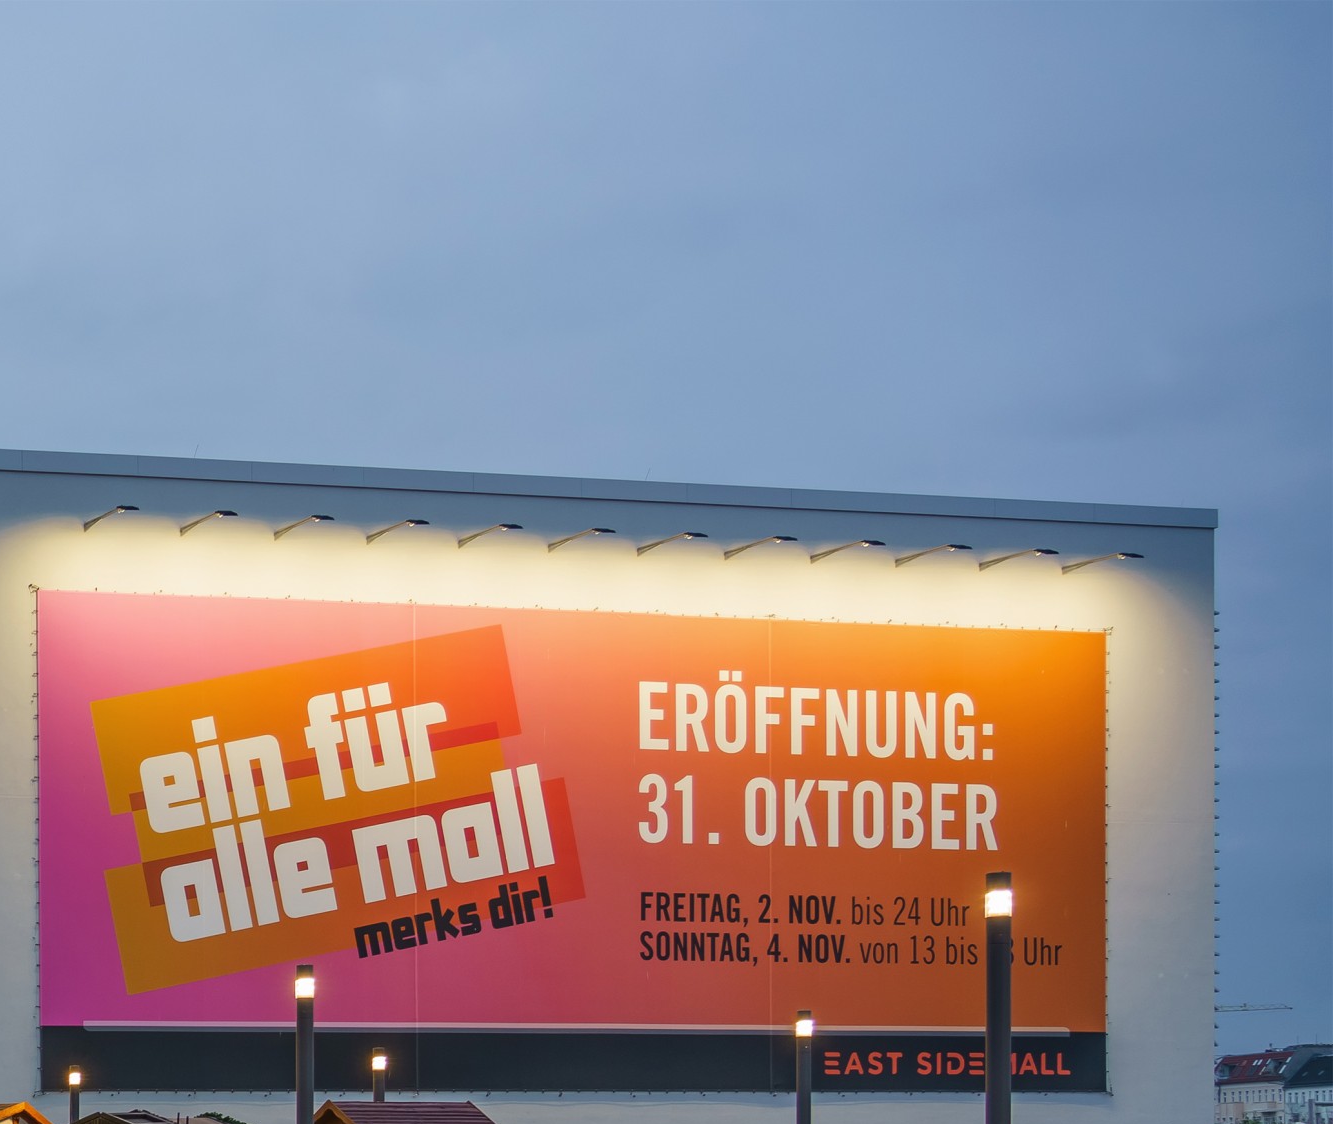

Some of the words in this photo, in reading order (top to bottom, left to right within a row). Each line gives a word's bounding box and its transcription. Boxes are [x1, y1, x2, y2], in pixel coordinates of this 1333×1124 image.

[638, 670, 994, 761] ERÖFFNUNG:
[139, 716, 291, 834] ein
[304, 682, 448, 801] für
[638, 773, 720, 846] 31.
[744, 776, 999, 851] OKTOBER
[160, 819, 338, 943] alle
[352, 763, 556, 905] mall
[353, 897, 481, 959] merks
[487, 875, 554, 930] dir!
[639, 891, 749, 929] FREITAG,
[757, 894, 780, 924] 2.
[788, 895, 842, 926] NOV.
[850, 896, 885, 926] bis
[893, 897, 922, 927] 24
[930, 897, 971, 928] Uhr
[639, 931, 759, 967] SONNTAG,
[766, 933, 789, 963] 4.
[797, 934, 851, 964] NOV.
[859, 942, 899, 965] von
[909, 935, 936, 965] 13
[945, 936, 979, 965] bis
[1023, 937, 1063, 966] Uhr
[824, 1052, 904, 1076] EAST
[916, 1052, 985, 1076] SIDE
